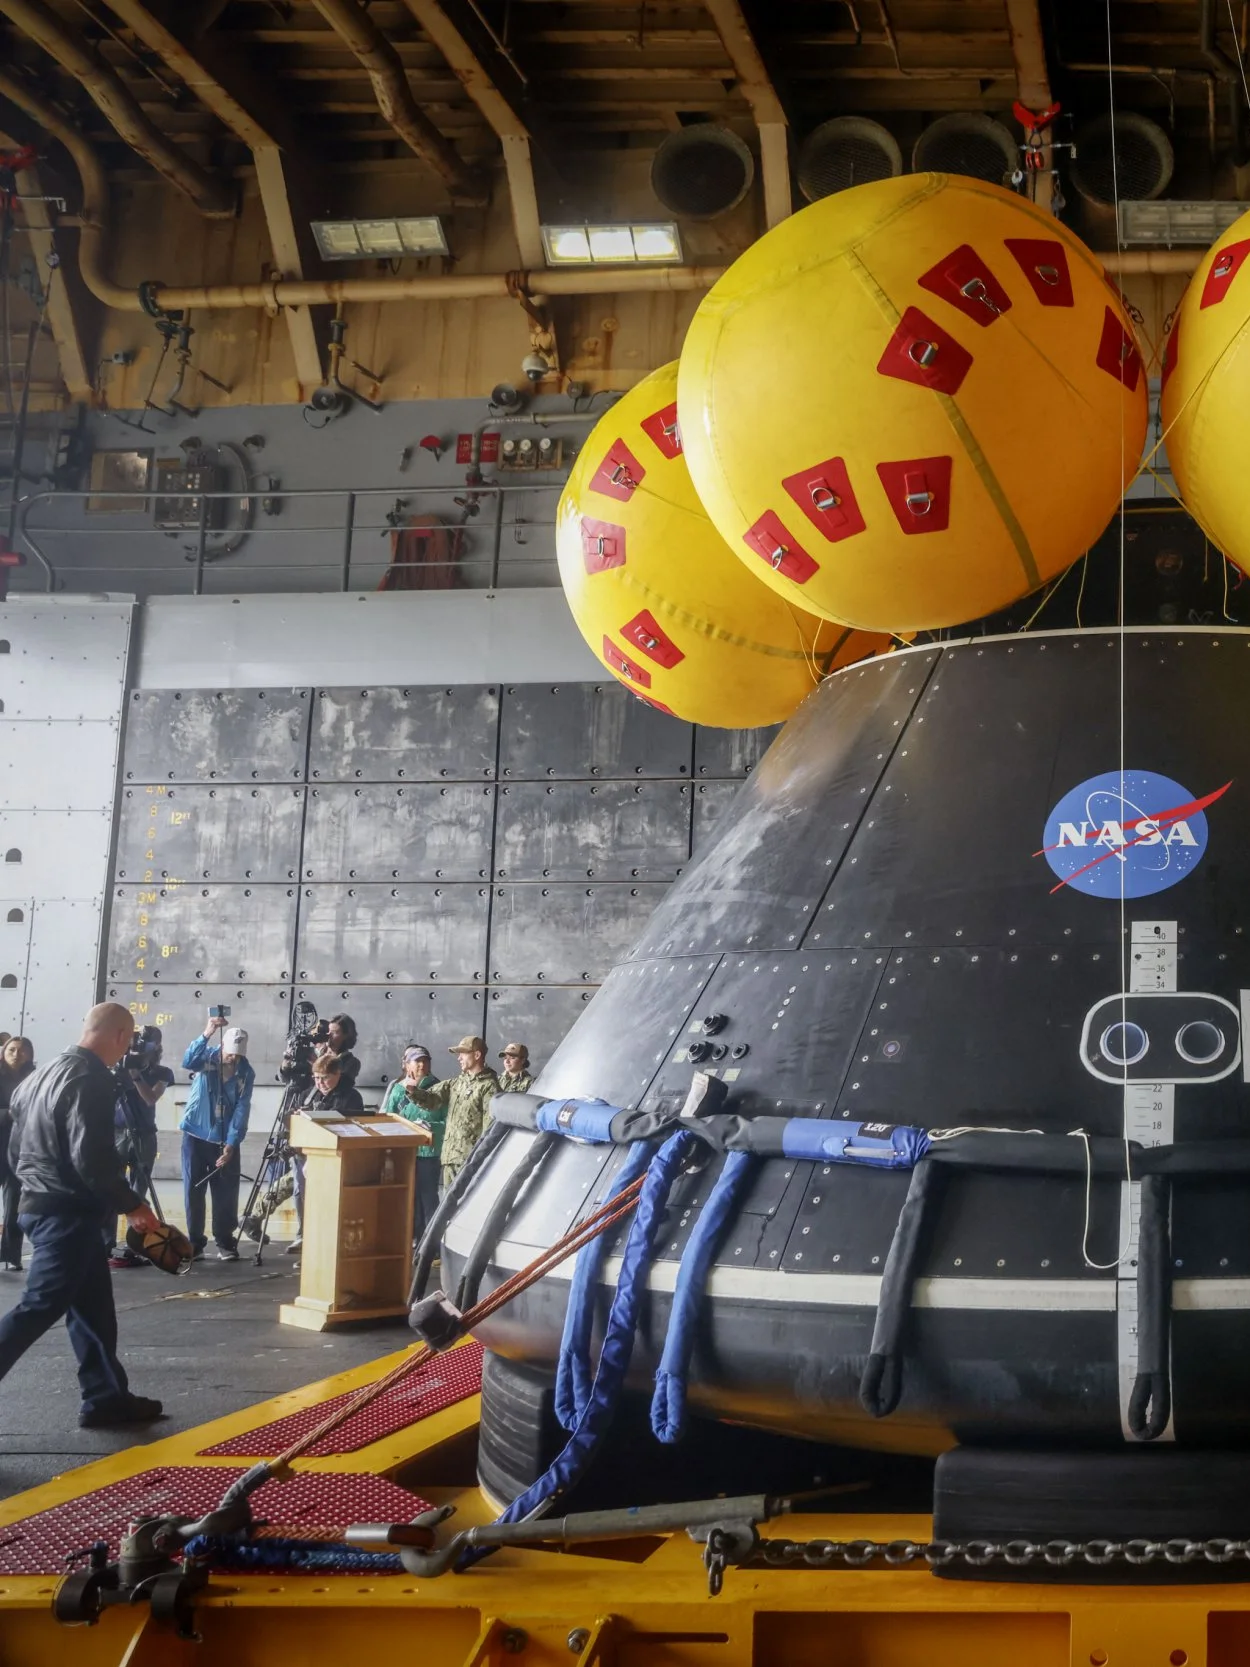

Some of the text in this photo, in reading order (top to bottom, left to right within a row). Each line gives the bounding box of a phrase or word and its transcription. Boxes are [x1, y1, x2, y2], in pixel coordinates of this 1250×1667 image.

[150, 805, 158, 817] 8
[147, 827, 156, 839] 6
[1056, 820, 1199, 848] NASA
[145, 848, 154, 861] 4
[144, 870, 153, 882] 2
[140, 913, 149, 926] 8
[138, 936, 147, 948] 6
[1157, 948, 1166, 956] 38
[136, 958, 145, 970] 4
[1156, 965, 1166, 973] 36
[136, 980, 144, 992] 2
[1156, 981, 1165, 989] 34
[1152, 1084, 1163, 1093] 22
[1152, 1102, 1163, 1111] 20
[1152, 1121, 1162, 1130] 18
[1151, 1140, 1161, 1148] 16
